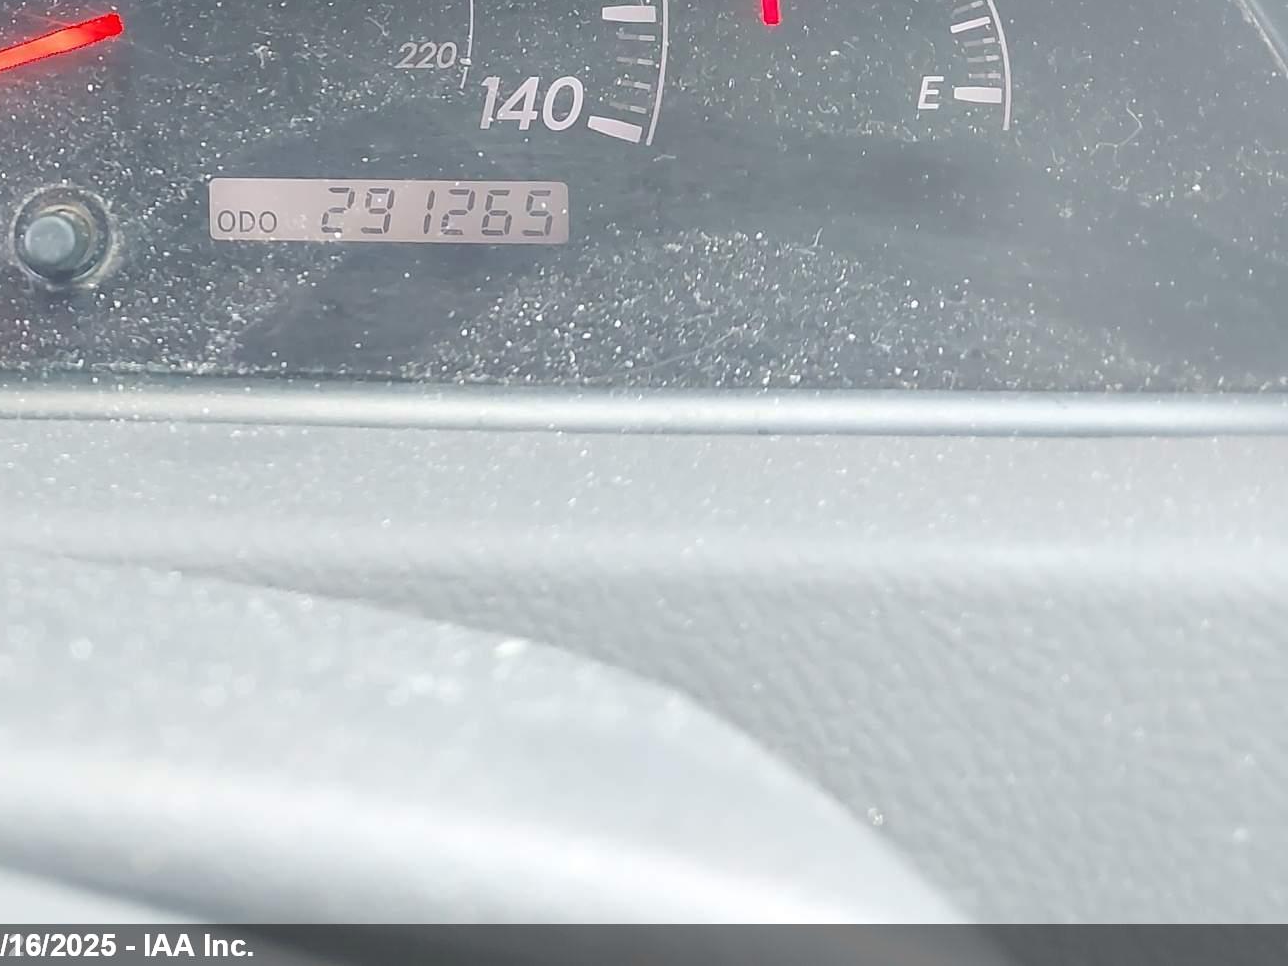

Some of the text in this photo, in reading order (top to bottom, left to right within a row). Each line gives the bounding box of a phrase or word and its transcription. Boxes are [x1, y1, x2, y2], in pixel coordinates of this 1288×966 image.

[398, 41, 458, 69] 220
[479, 75, 584, 131] 140
[917, 76, 945, 110] E
[217, 186, 553, 237] ODO 291265
